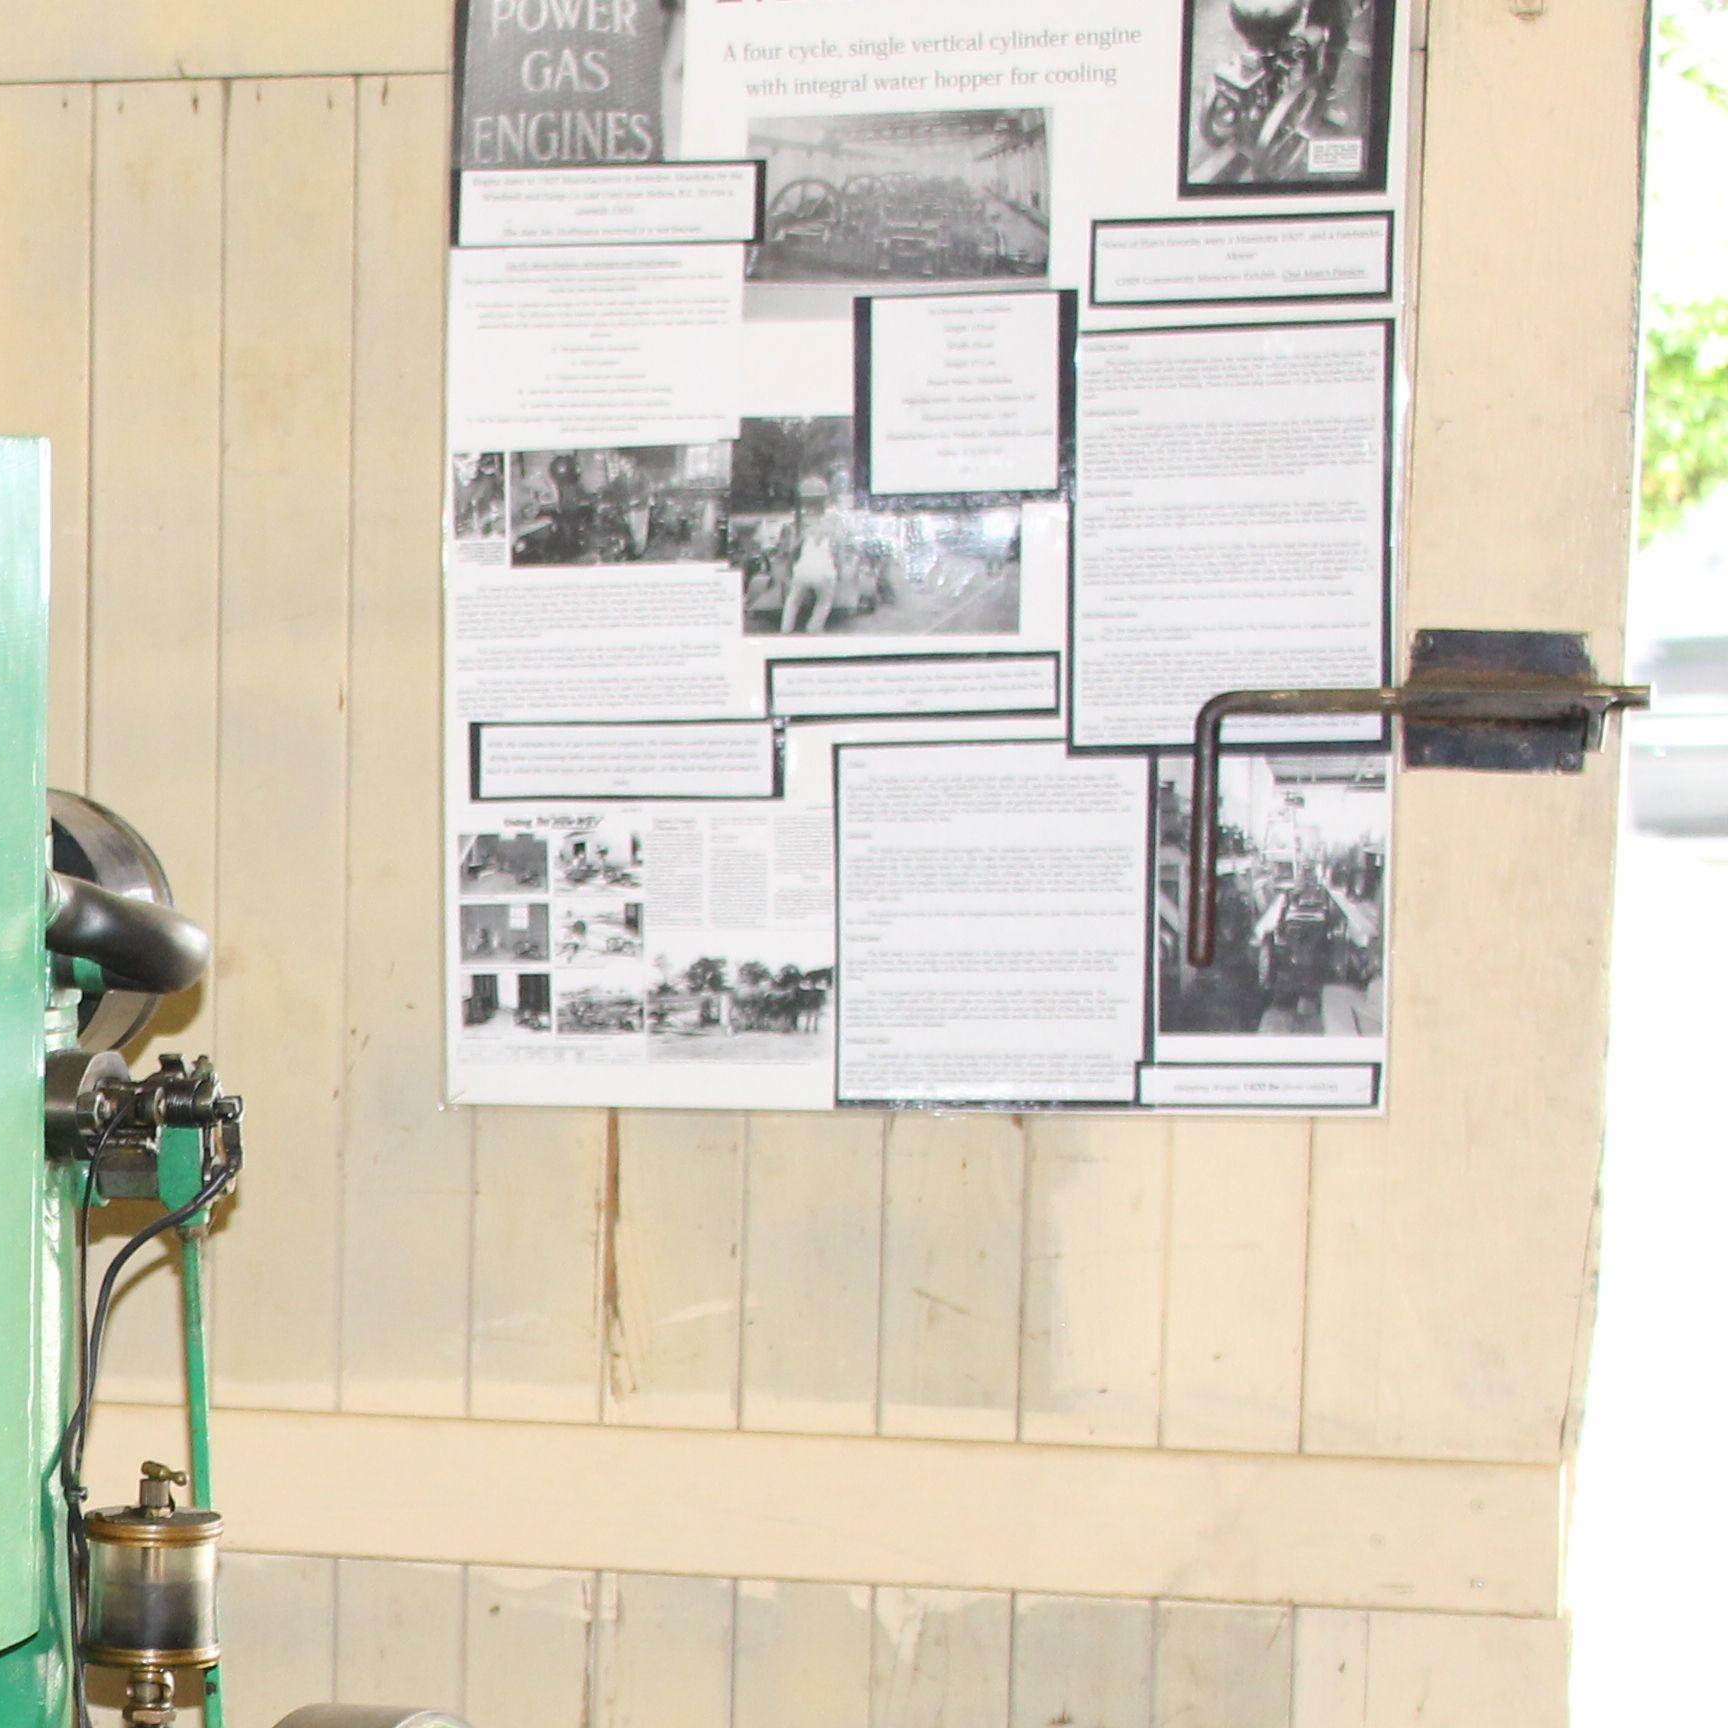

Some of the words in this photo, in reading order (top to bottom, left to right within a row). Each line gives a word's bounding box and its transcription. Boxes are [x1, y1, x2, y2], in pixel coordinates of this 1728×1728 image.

[723, 43, 737, 62] A
[743, 39, 781, 62] four
[849, 36, 905, 61] single
[911, 31, 983, 55] vertical
[989, 28, 1069, 55] cylinder
[1075, 26, 1141, 51] engine
[520, 49, 611, 93] GAS
[746, 77, 787, 97] with
[793, 73, 867, 98] integral
[873, 72, 928, 92] water
[934, 69, 1004, 94] hopper
[1010, 65, 1039, 86] for
[1045, 62, 1117, 89] cooling
[471, 111, 654, 164] ENGINES
